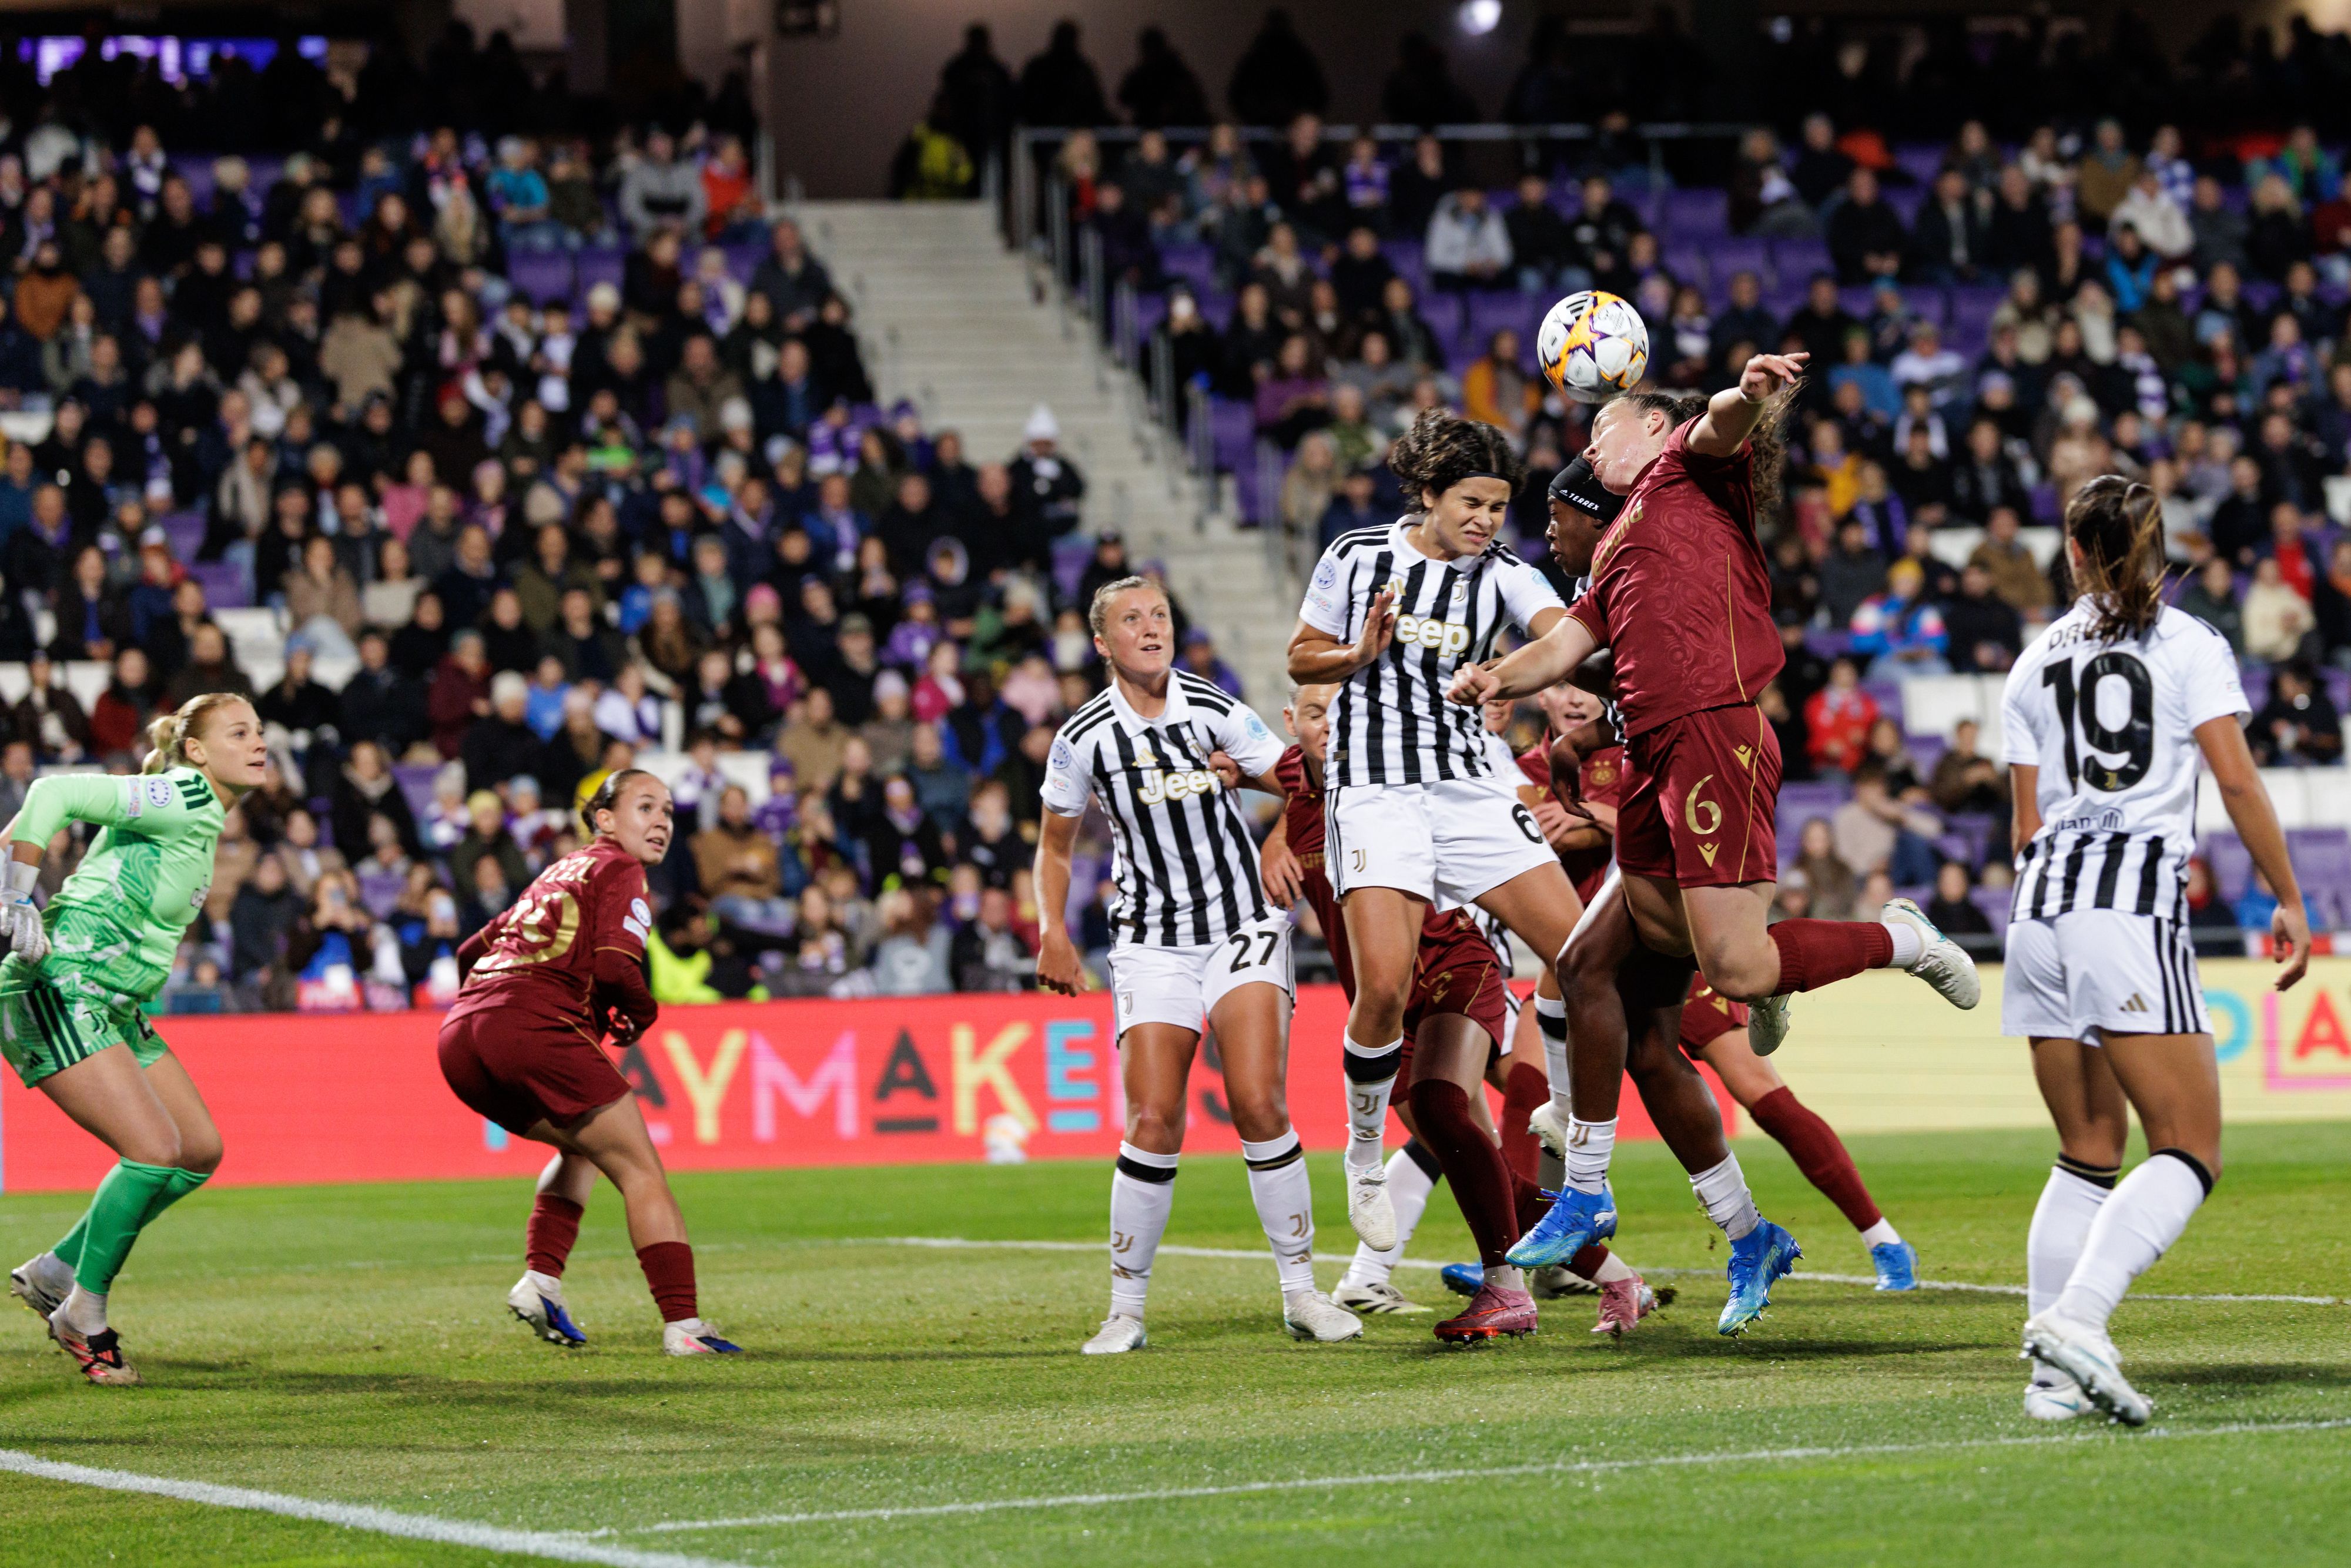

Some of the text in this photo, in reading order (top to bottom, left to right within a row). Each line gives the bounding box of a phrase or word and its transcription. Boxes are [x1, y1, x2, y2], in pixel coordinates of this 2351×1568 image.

[1568, 492, 1599, 511] TERREX
[1593, 498, 1644, 578] erbund
[2042, 652, 2154, 796] 19
[1512, 803, 1543, 845] 6
[1685, 774, 1722, 835] 6
[1228, 931, 1279, 974] 27
[483, 1018, 1234, 1153] AYMAKE
